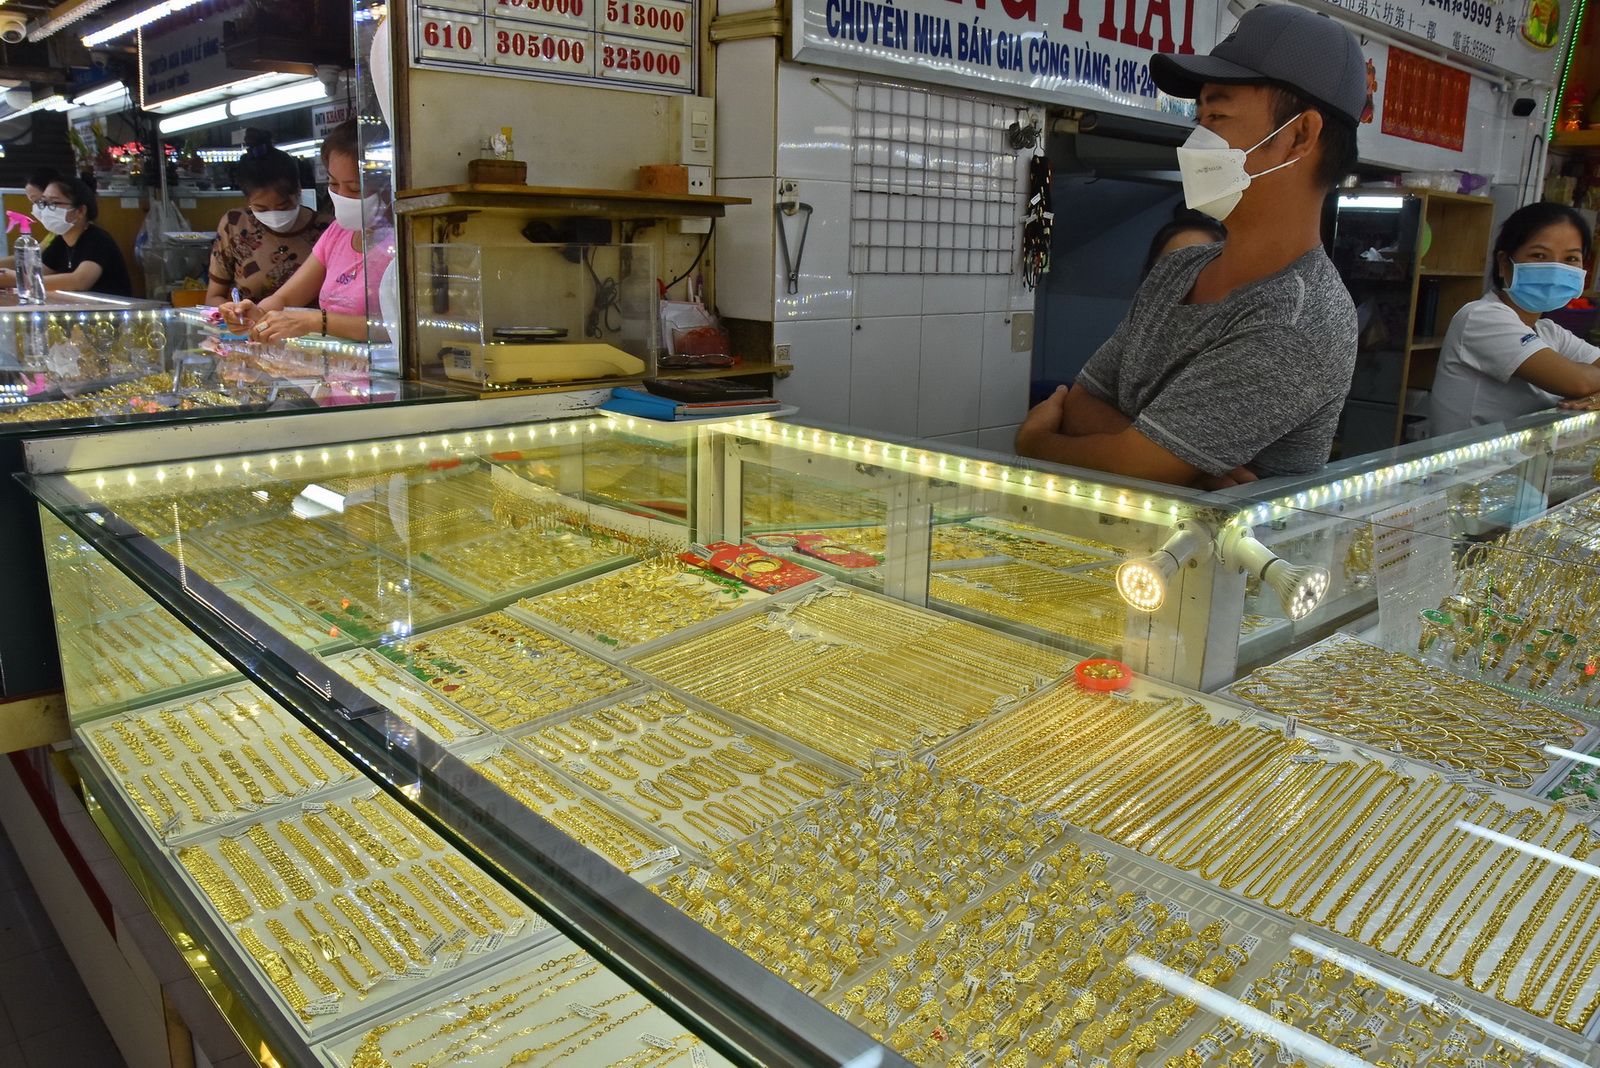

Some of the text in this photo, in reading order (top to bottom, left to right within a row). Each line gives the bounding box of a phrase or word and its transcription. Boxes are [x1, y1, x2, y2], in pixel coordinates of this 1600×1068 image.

[607, 0, 684, 32] 513000
[424, 22, 472, 49] 610
[497, 31, 584, 63] 305000
[826, 0, 908, 50] CHUYÊN
[914, 13, 952, 58] MUA
[958, 16, 993, 66] BÁN
[997, 31, 1023, 72] GIA
[1029, 30, 1069, 80] CÔNG
[1075, 41, 1110, 89] VÀNG
[603, 46, 680, 75] 325000
